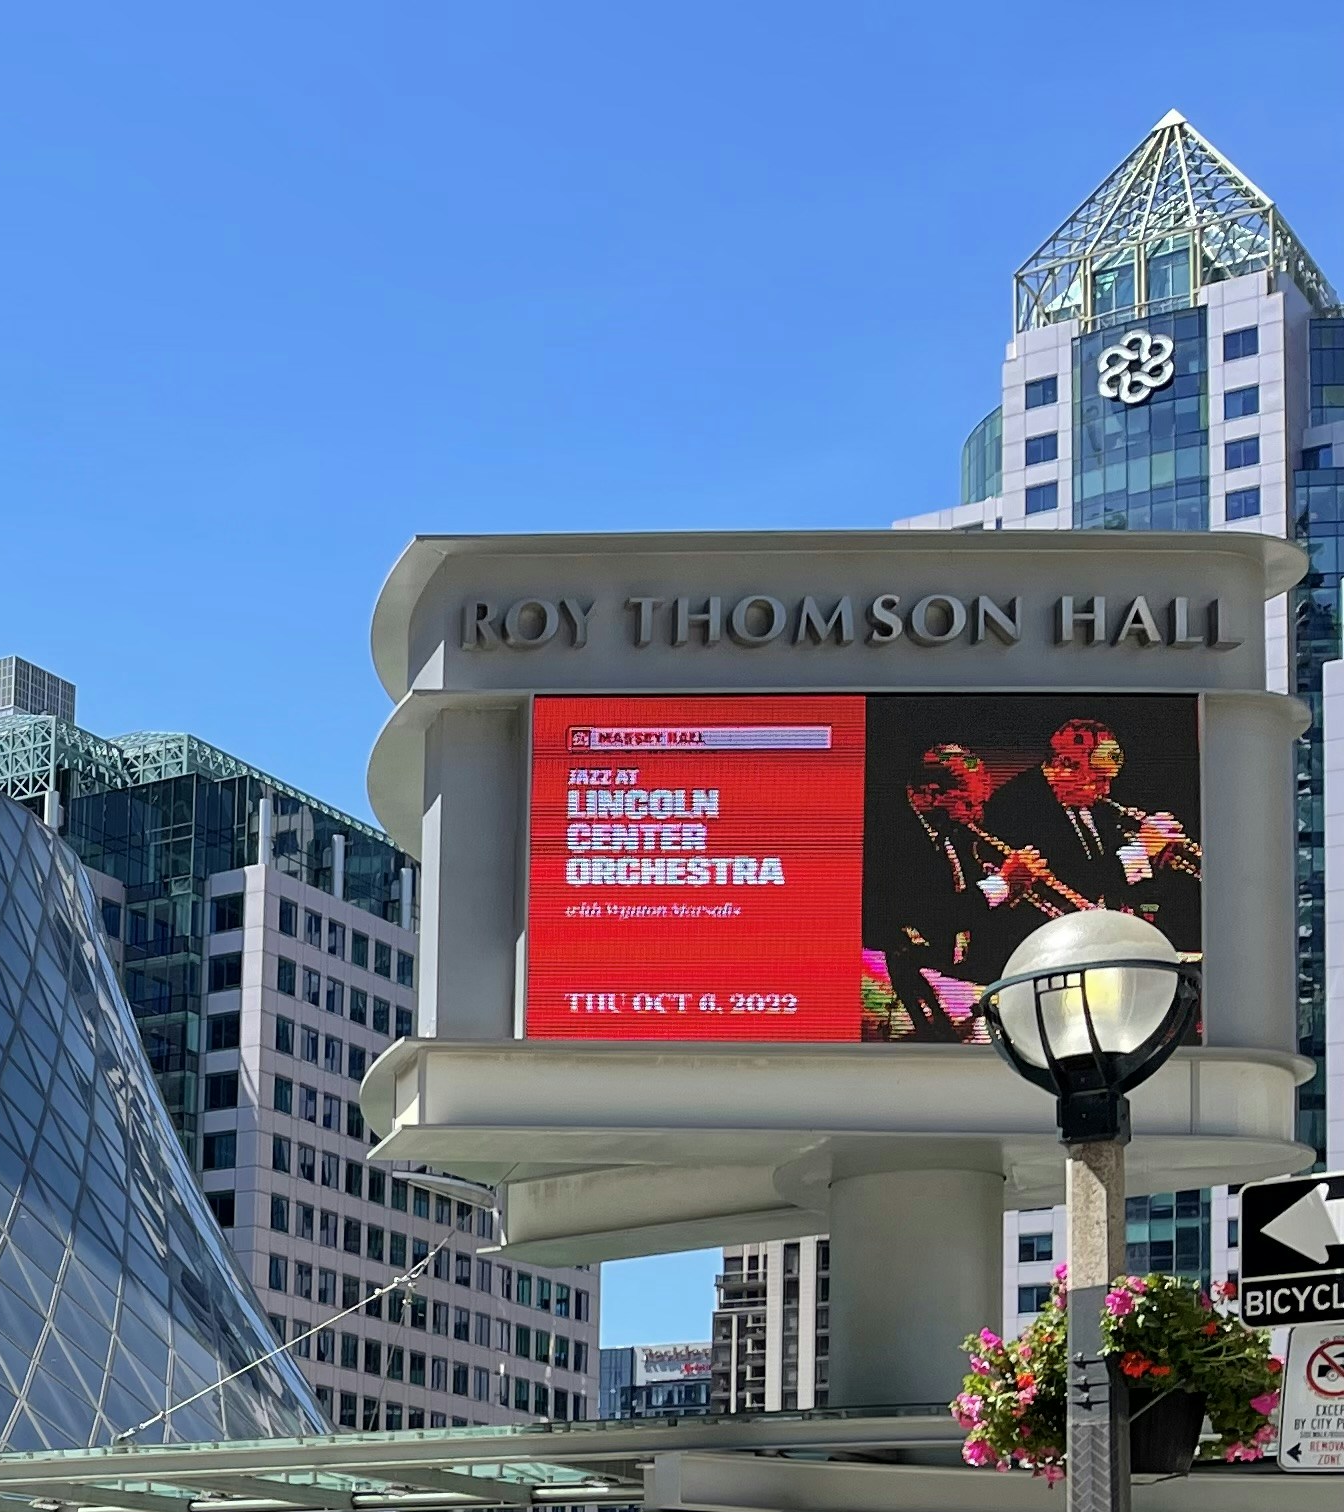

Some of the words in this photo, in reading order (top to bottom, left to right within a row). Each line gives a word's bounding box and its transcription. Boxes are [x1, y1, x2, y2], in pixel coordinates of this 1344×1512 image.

[461, 599, 597, 651] ROY
[625, 594, 1022, 648] THOMSON
[1055, 595, 1244, 649] HALL
[567, 768, 612, 785] JAZZ
[615, 768, 639, 785] AT
[567, 788, 719, 819] LINCOLN
[567, 823, 707, 851] CENTER
[565, 856, 785, 886] ORCHESTRA
[564, 992, 627, 1014] THU
[632, 992, 693, 1014] OCT
[729, 992, 799, 1014] 2022
[1311, 1418, 1332, 1430] CITY
